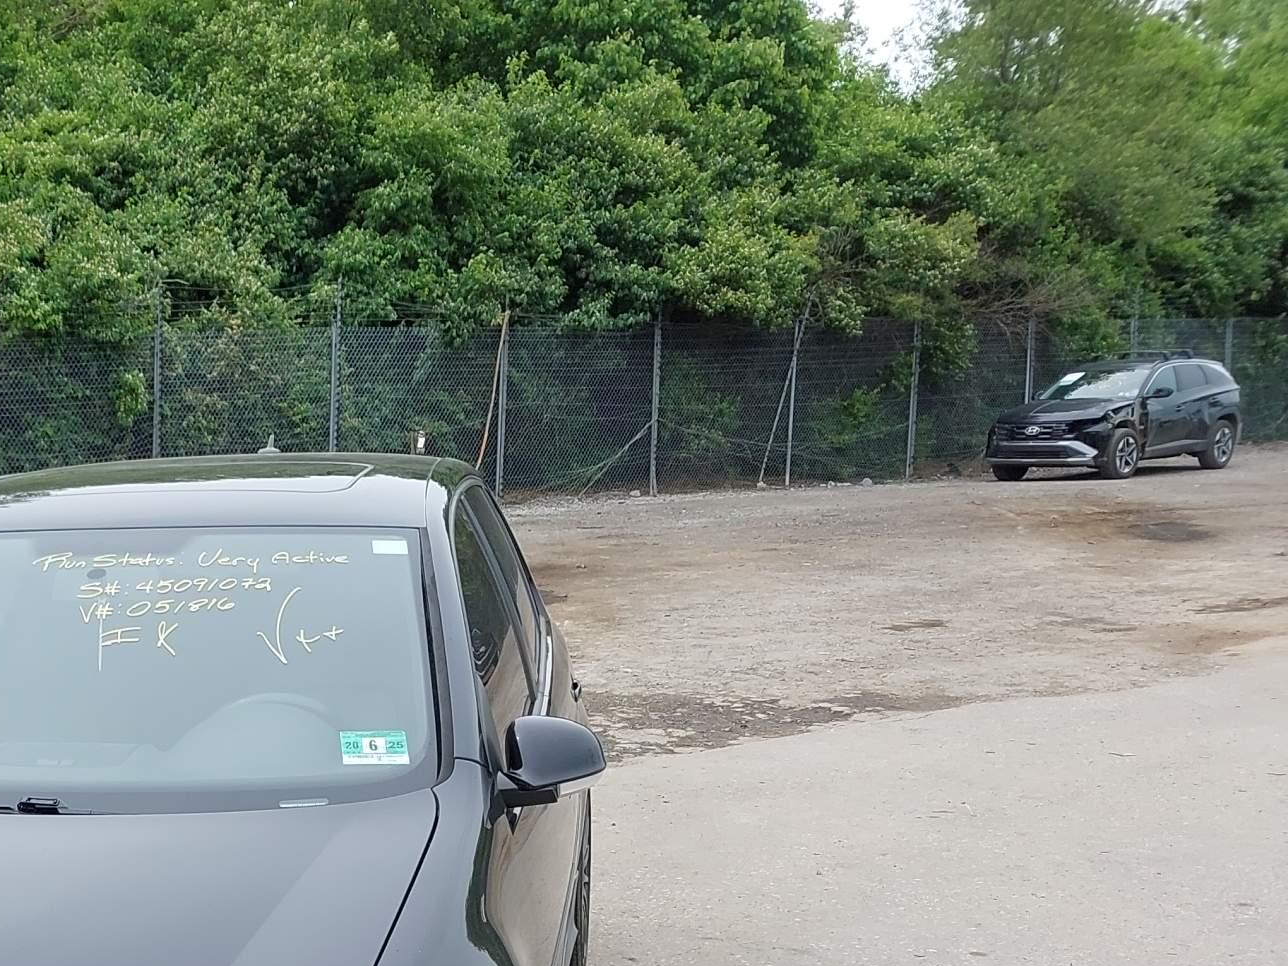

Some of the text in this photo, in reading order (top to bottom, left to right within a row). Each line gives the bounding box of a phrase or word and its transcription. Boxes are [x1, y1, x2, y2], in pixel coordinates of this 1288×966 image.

[198, 549, 260, 573] Very
[271, 551, 350, 564] Active
[136, 577, 271, 593] 45091072
[126, 598, 235, 616] 051816
[369, 739, 378, 751] 6
[388, 741, 404, 749] 25
